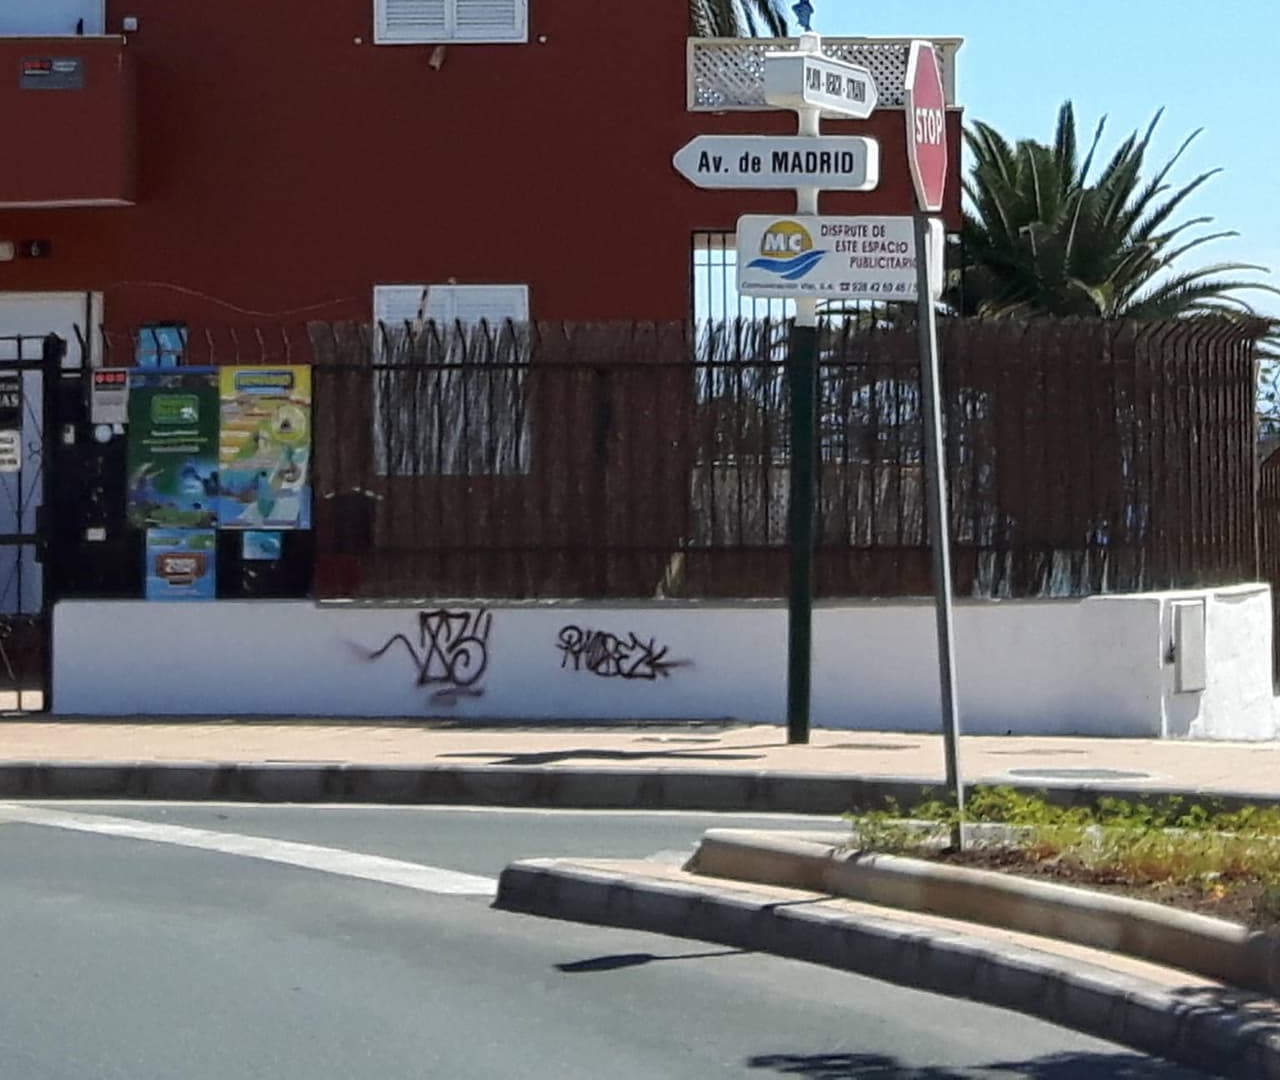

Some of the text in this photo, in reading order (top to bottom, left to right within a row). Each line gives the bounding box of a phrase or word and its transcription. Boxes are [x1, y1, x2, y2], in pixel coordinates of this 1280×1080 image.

[915, 109, 943, 145] STOP
[697, 151, 854, 174] Av. de MADRID
[820, 224, 885, 237] DISFRUTE DE
[835, 240, 908, 253] ESTE ESPACIO
